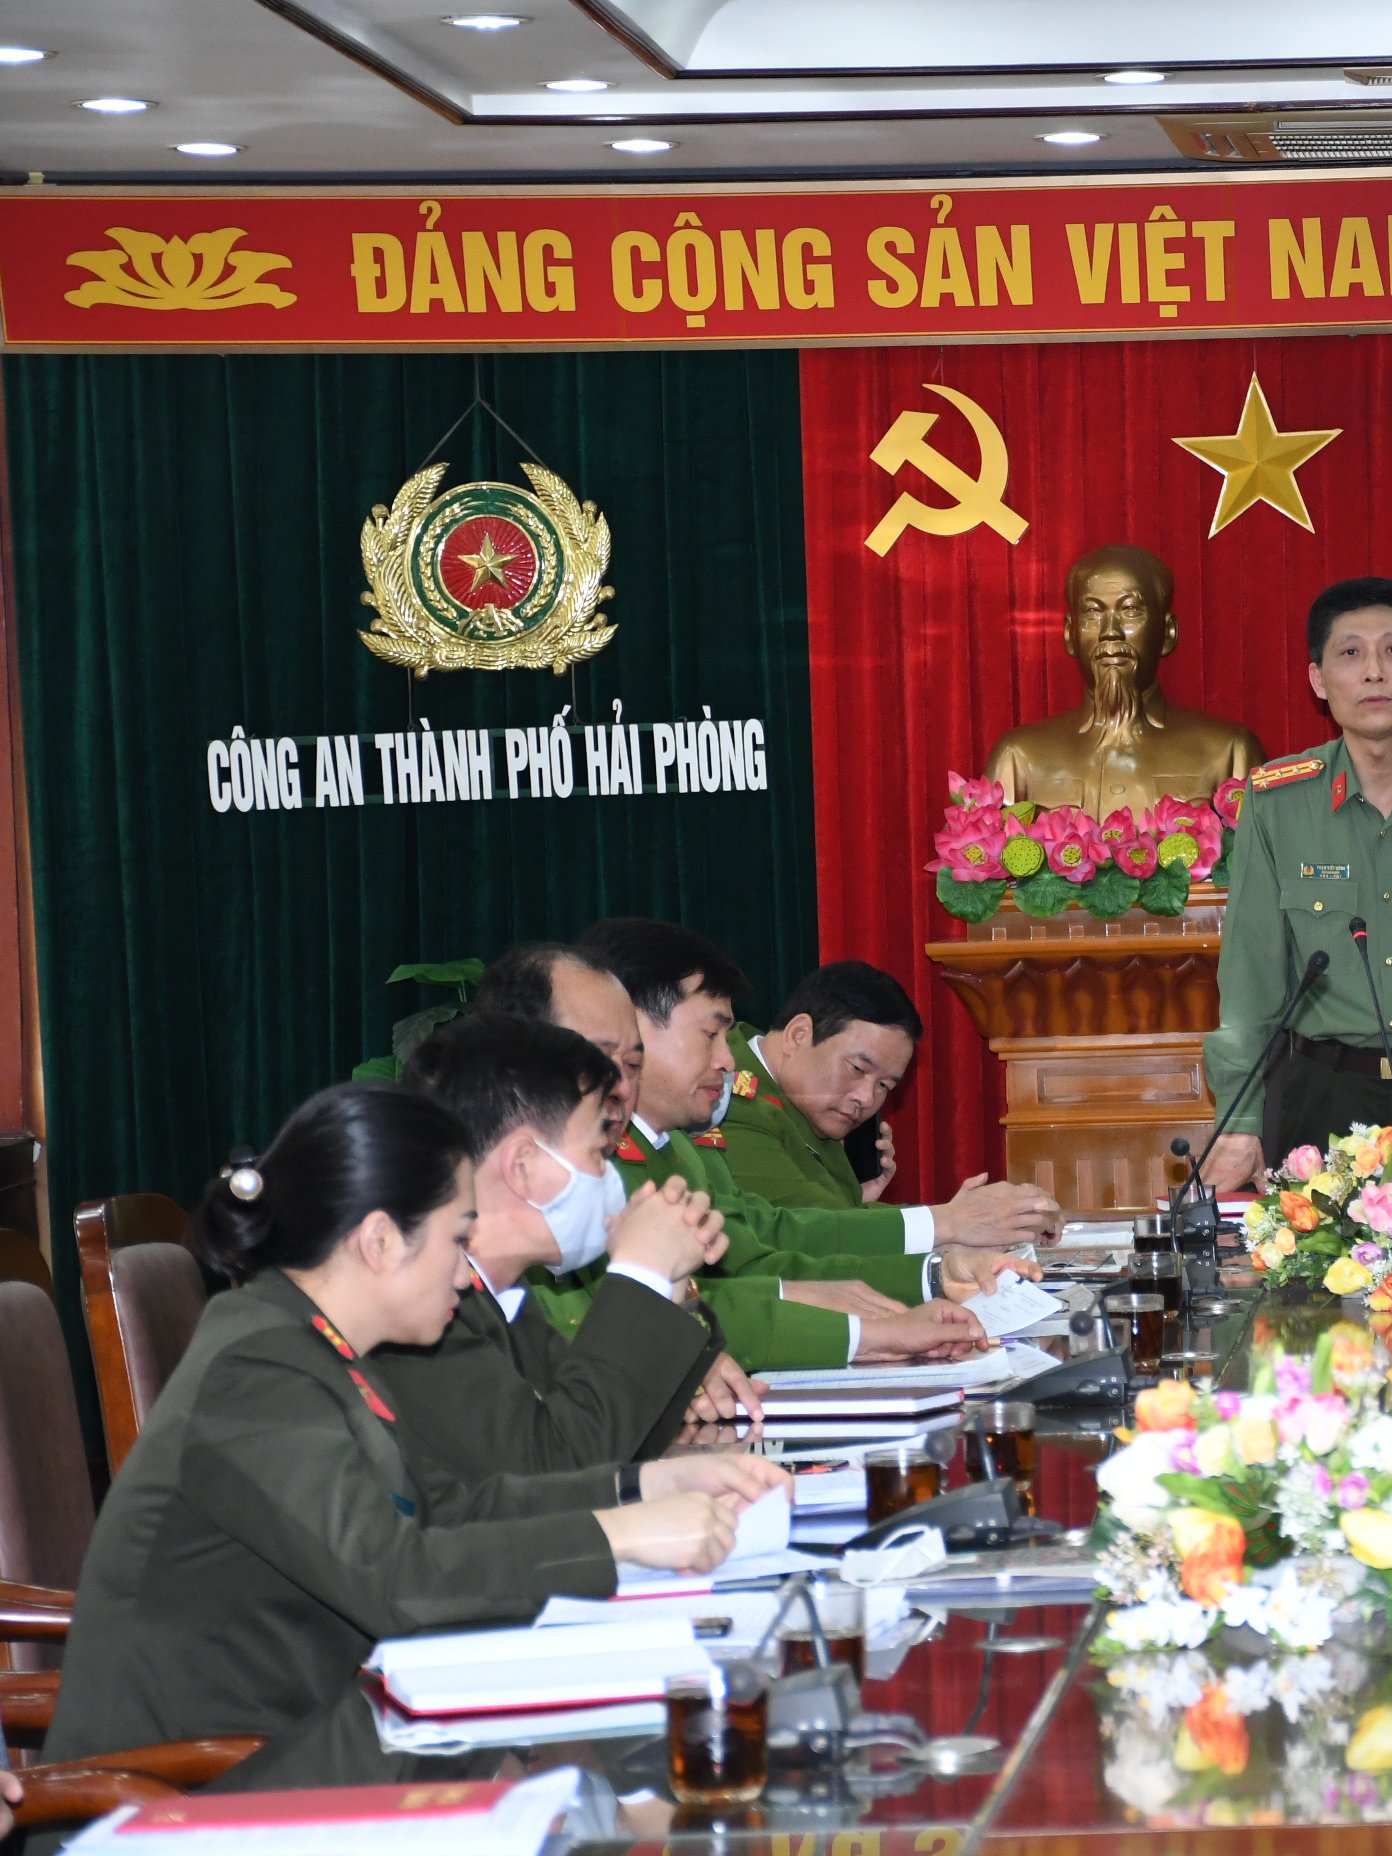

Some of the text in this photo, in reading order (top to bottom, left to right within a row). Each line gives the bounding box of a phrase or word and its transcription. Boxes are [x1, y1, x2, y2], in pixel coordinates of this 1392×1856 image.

[351, 201, 575, 313] ĐẢNG
[612, 212, 834, 327] CỘNG
[867, 194, 1033, 308] SẢN
[1066, 205, 1234, 318] VIỆT
[208, 699, 767, 812] CÔNG AN THÀNH PHỐ HẢI PHÒNG
